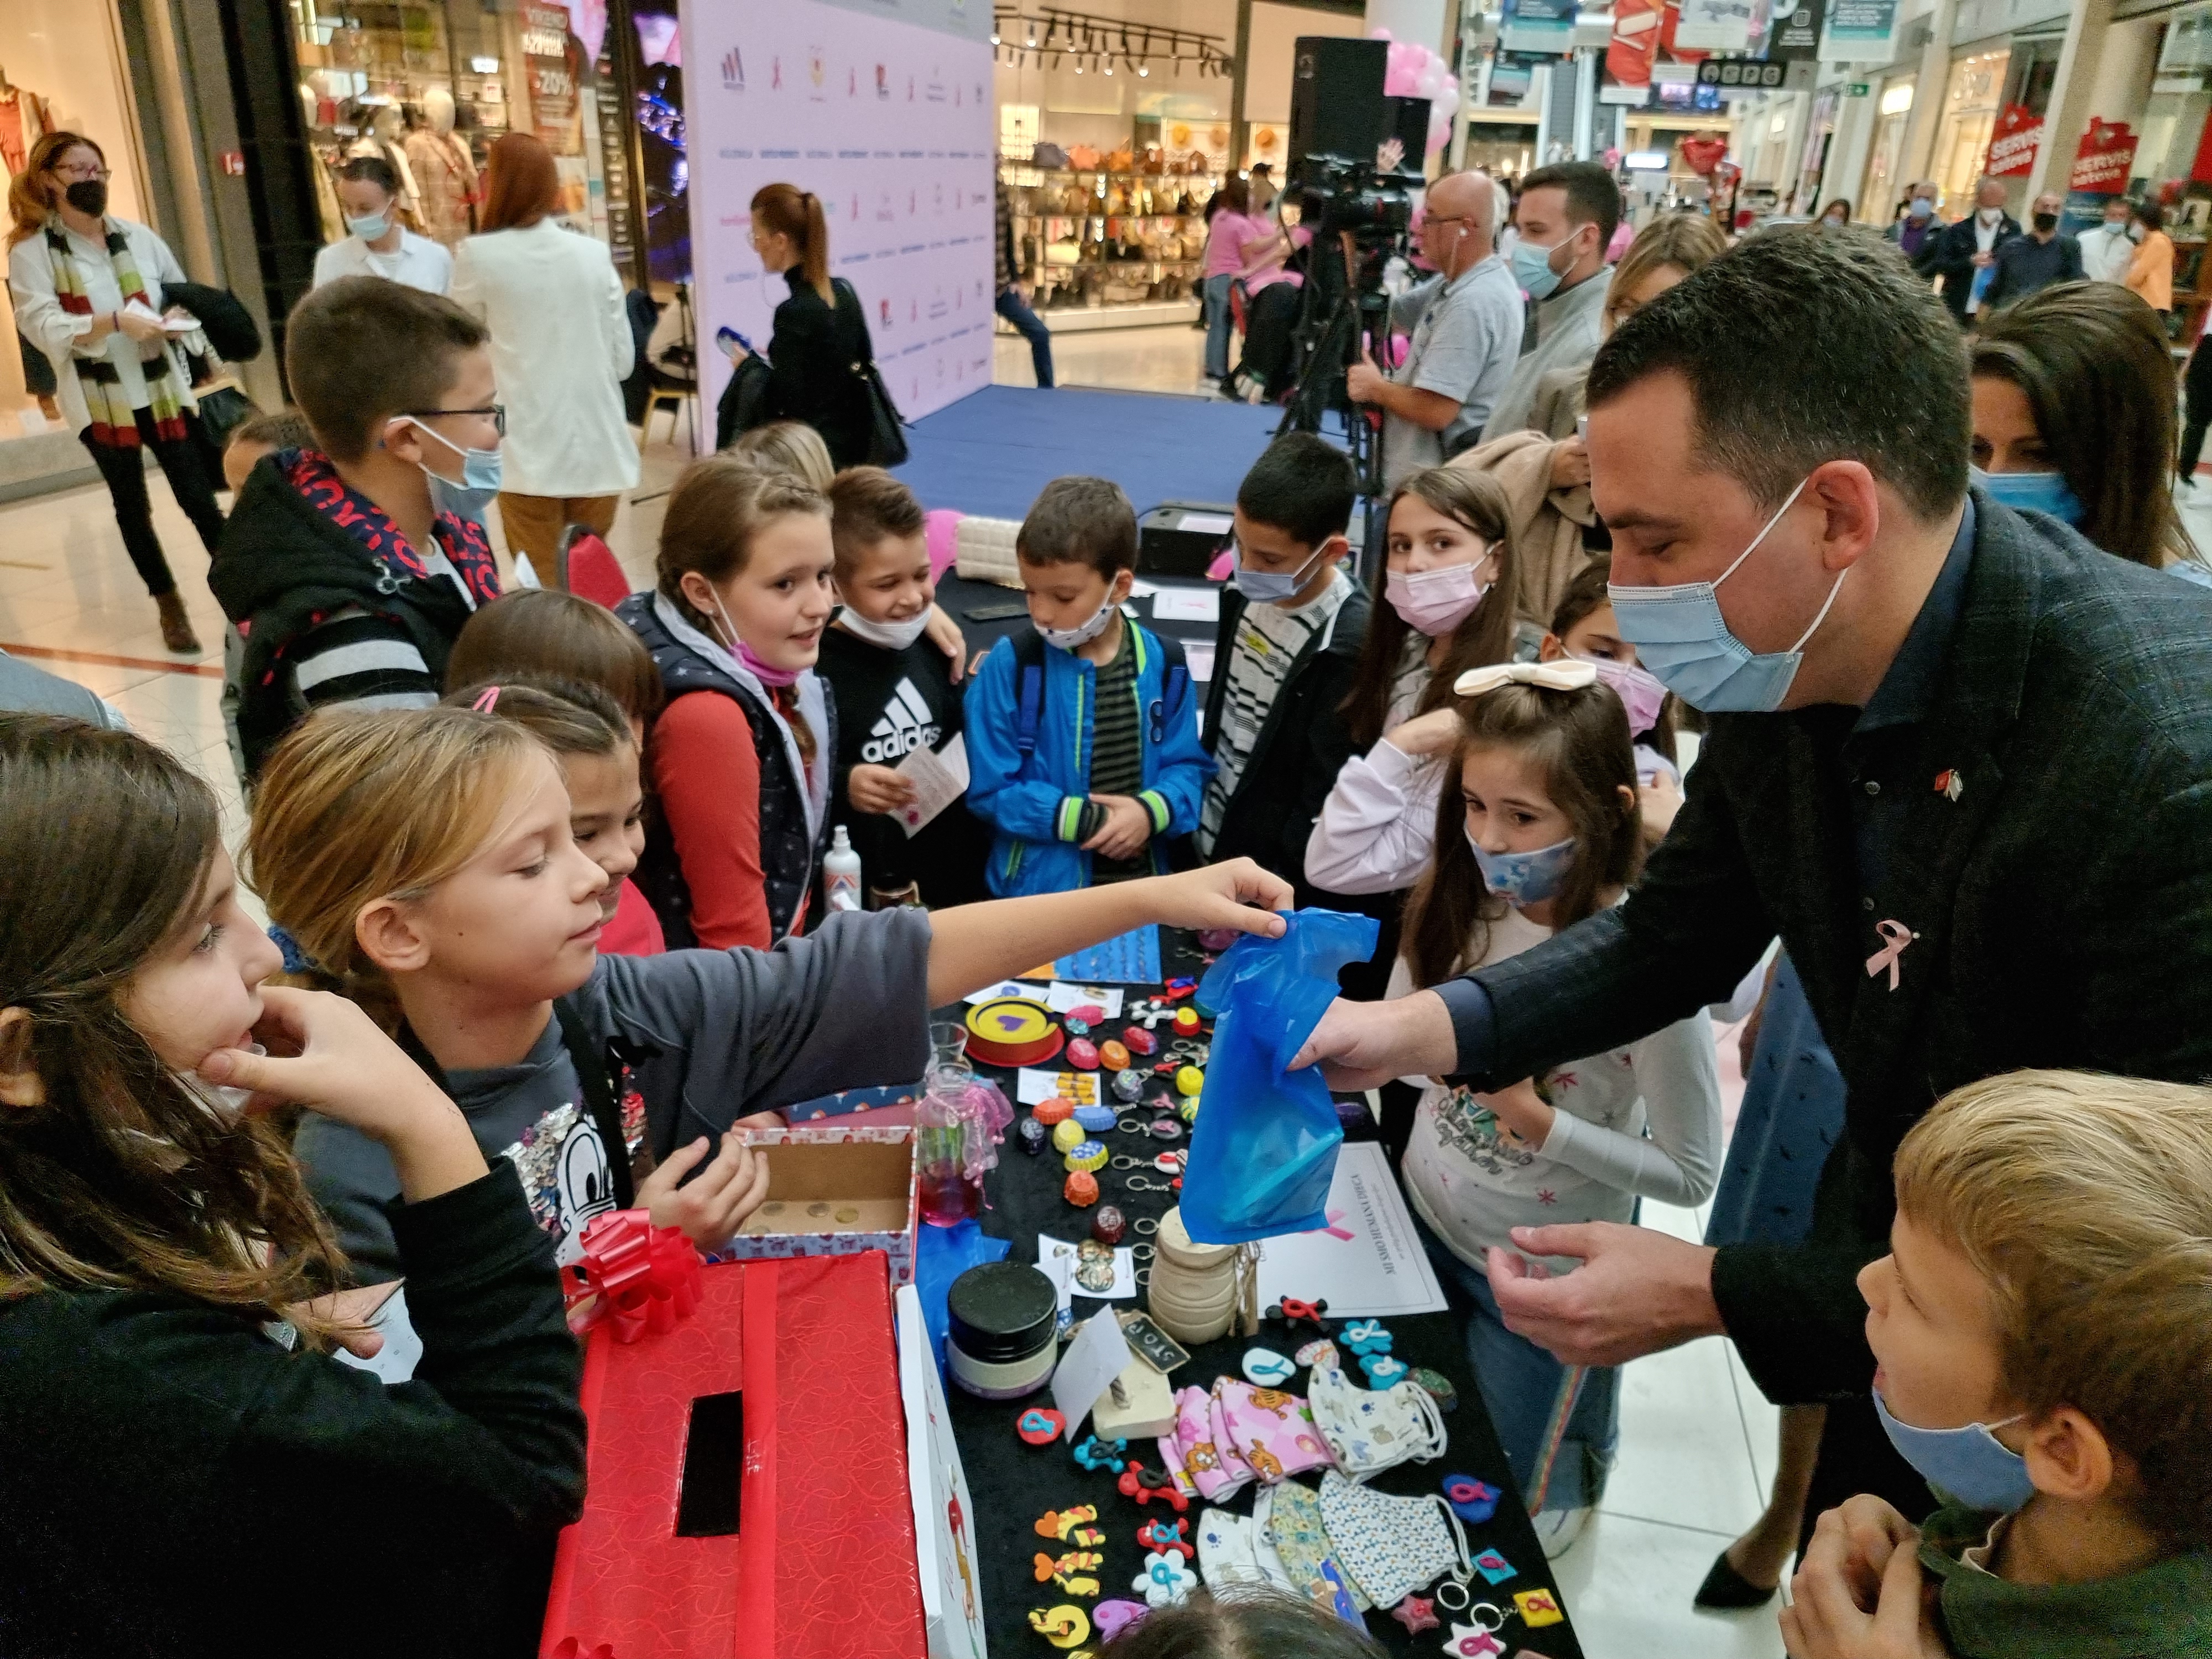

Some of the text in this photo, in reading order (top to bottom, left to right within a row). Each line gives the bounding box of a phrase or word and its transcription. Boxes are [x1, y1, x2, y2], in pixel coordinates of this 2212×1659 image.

[2074, 148, 2131, 175] SERVIS
[861, 723, 941, 763] adidas
[1128, 1323, 1175, 1361] STOP
